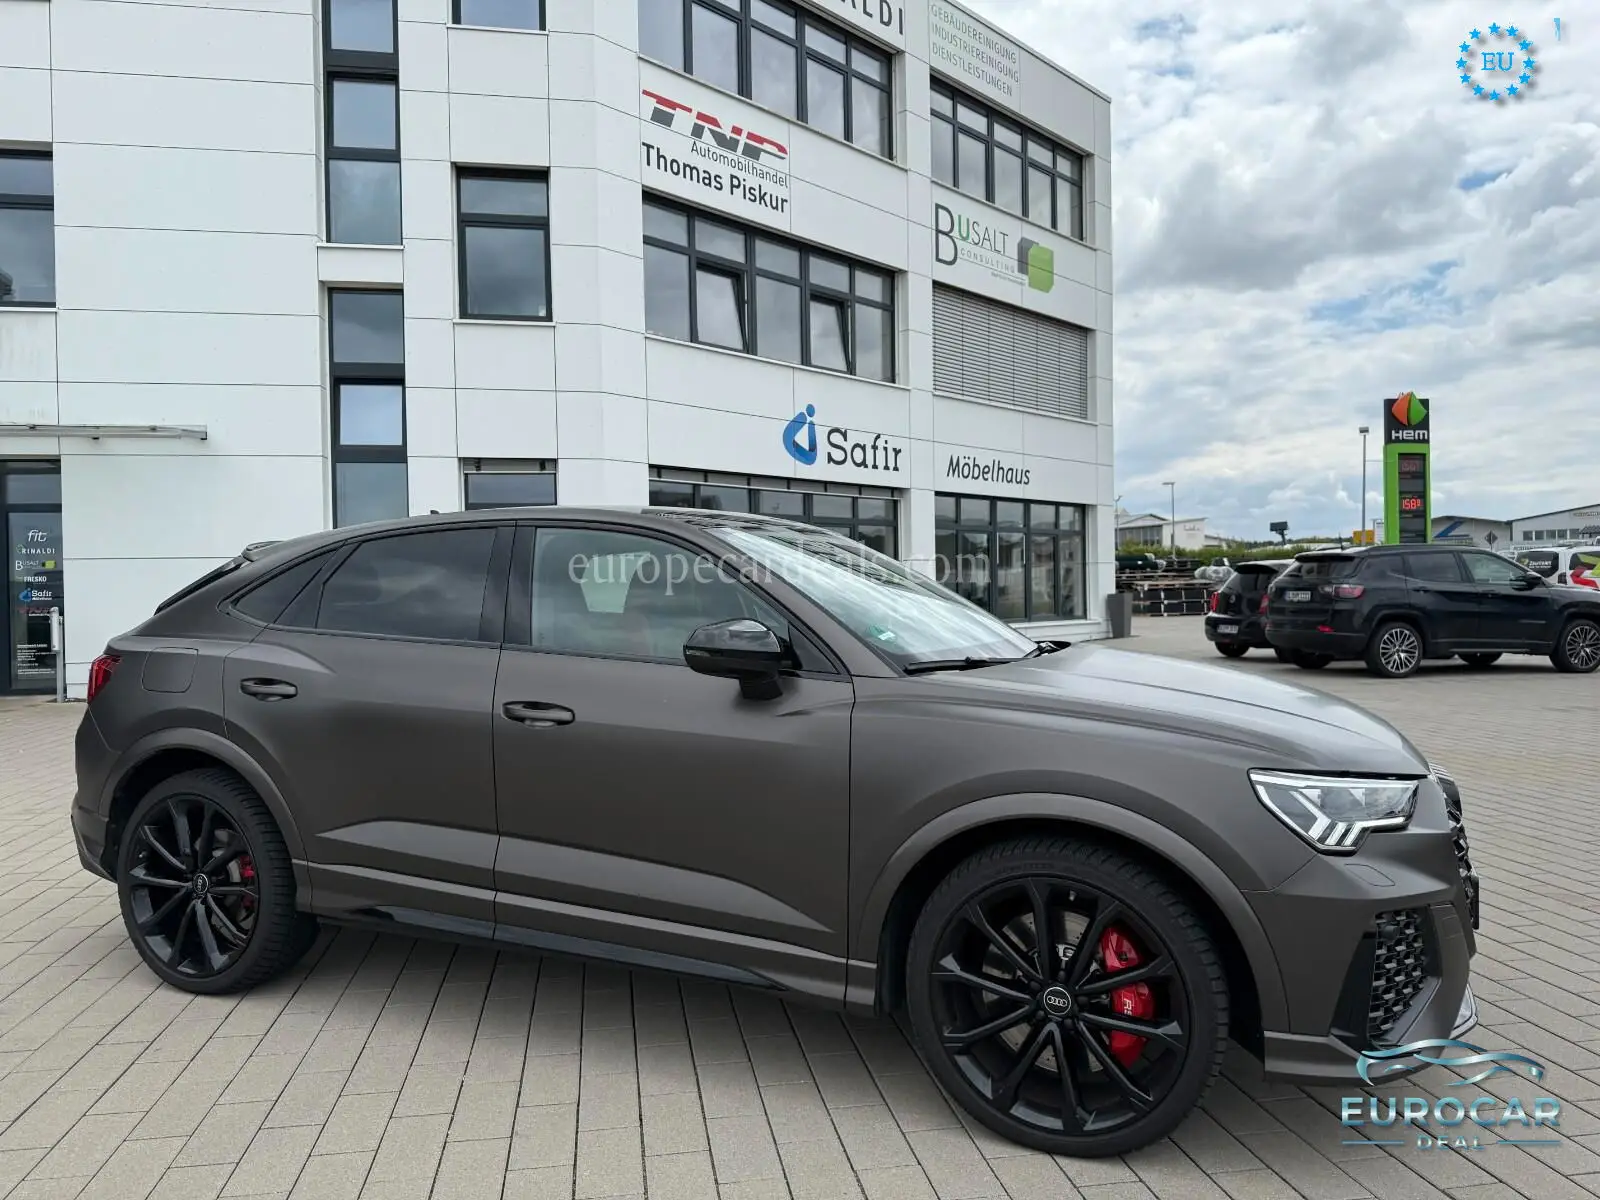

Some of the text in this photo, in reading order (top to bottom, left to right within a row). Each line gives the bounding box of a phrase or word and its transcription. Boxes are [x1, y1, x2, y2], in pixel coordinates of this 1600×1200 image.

[842, 0, 904, 35] LDI
[931, 23, 1020, 83] INDUSTRIEREINIGUNG
[931, 42, 1013, 97] DIENSTLEISTUNGEN
[641, 141, 788, 213] Thomas Piskur
[690, 140, 788, 188] Automobilhandel
[826, 427, 902, 472] Safir
[946, 453, 1031, 486] Möbelhaus
[27, 529, 48, 542] fit
